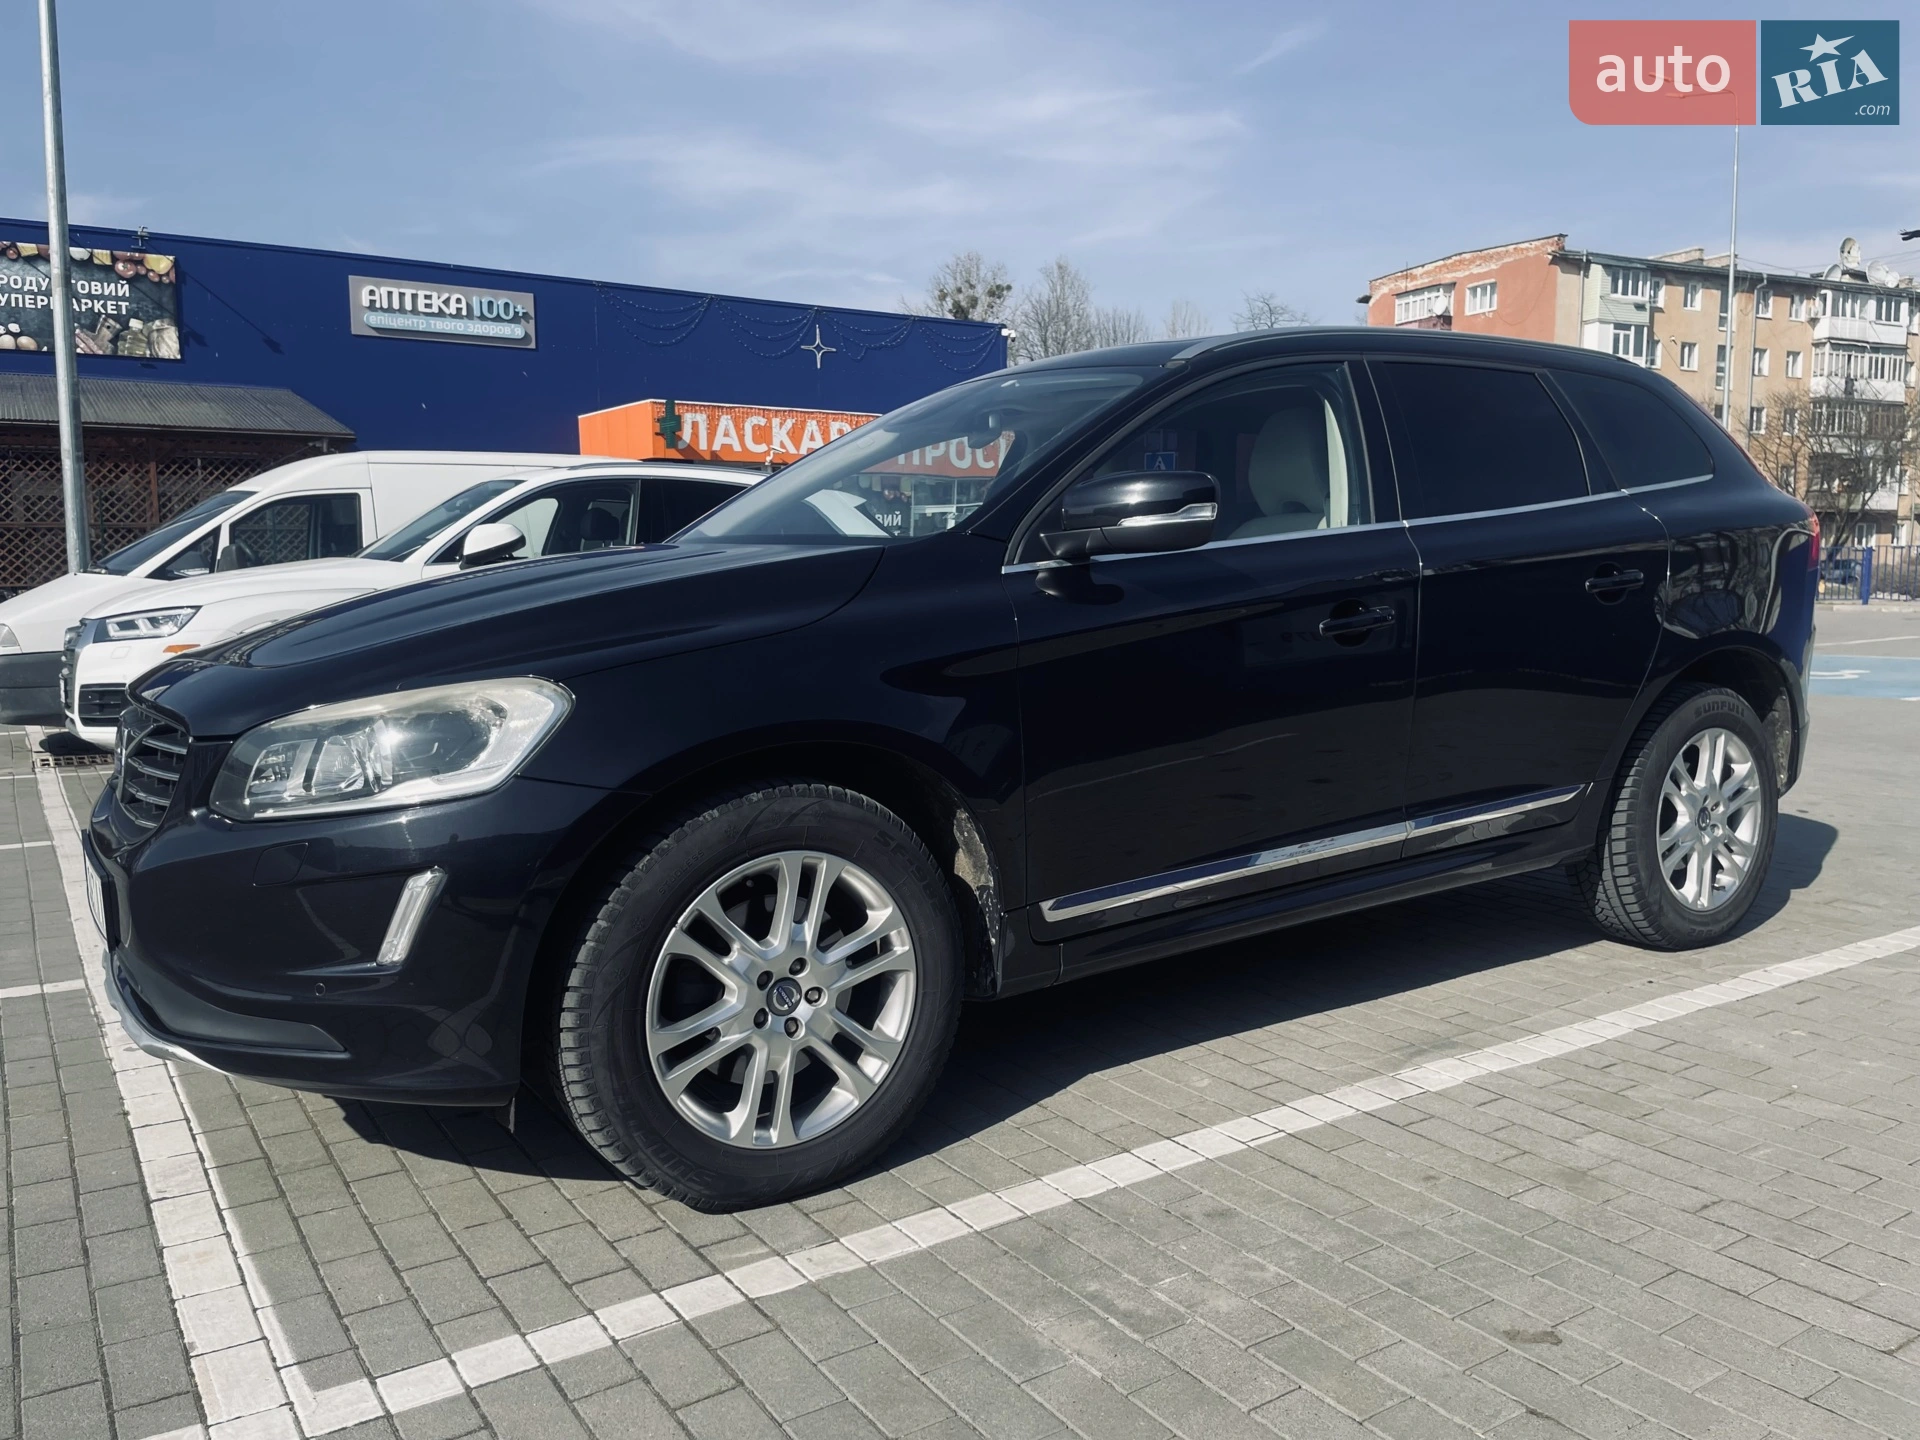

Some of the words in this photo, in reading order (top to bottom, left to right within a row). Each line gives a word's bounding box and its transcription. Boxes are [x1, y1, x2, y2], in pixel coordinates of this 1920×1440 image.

[0, 274, 130, 298] РОДУОВИЙ
[0, 293, 130, 315] УПЕРАРКЕТ
[361, 285, 468, 317] АПТЕКА
[472, 295, 528, 320] 100+
[369, 314, 427, 330] епіцентр
[429, 319, 465, 331] твого
[1694, 700, 1744, 719] SUNFULL
[658, 850, 705, 895] STUDLESS
[871, 828, 944, 918] SF-982
